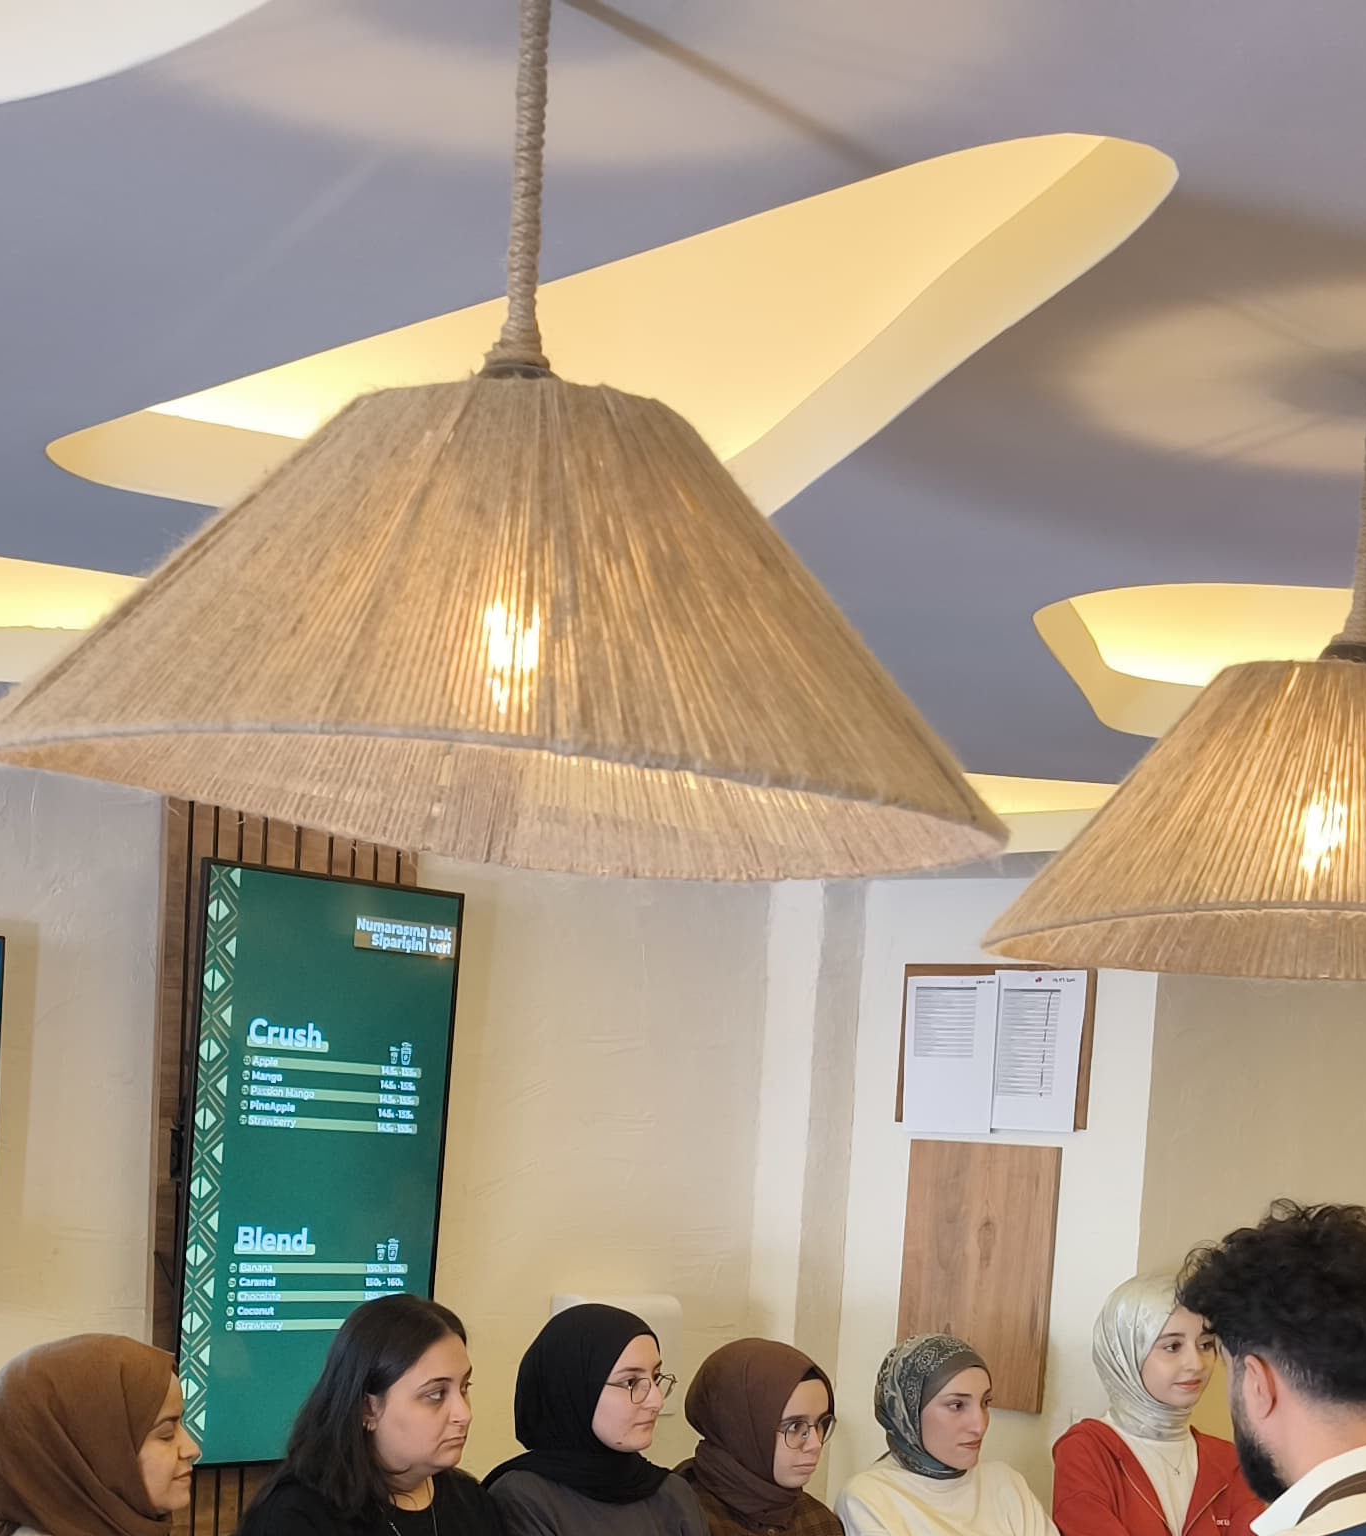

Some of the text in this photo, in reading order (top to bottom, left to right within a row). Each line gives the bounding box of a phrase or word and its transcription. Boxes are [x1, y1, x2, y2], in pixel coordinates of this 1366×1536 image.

[356, 917, 451, 941] Numarasına bak
[249, 1018, 322, 1048] Crush
[251, 1070, 283, 1083] Mango
[285, 1087, 315, 1100] Mango
[237, 1226, 307, 1252] Blend
[238, 1277, 276, 1287] Caramel
